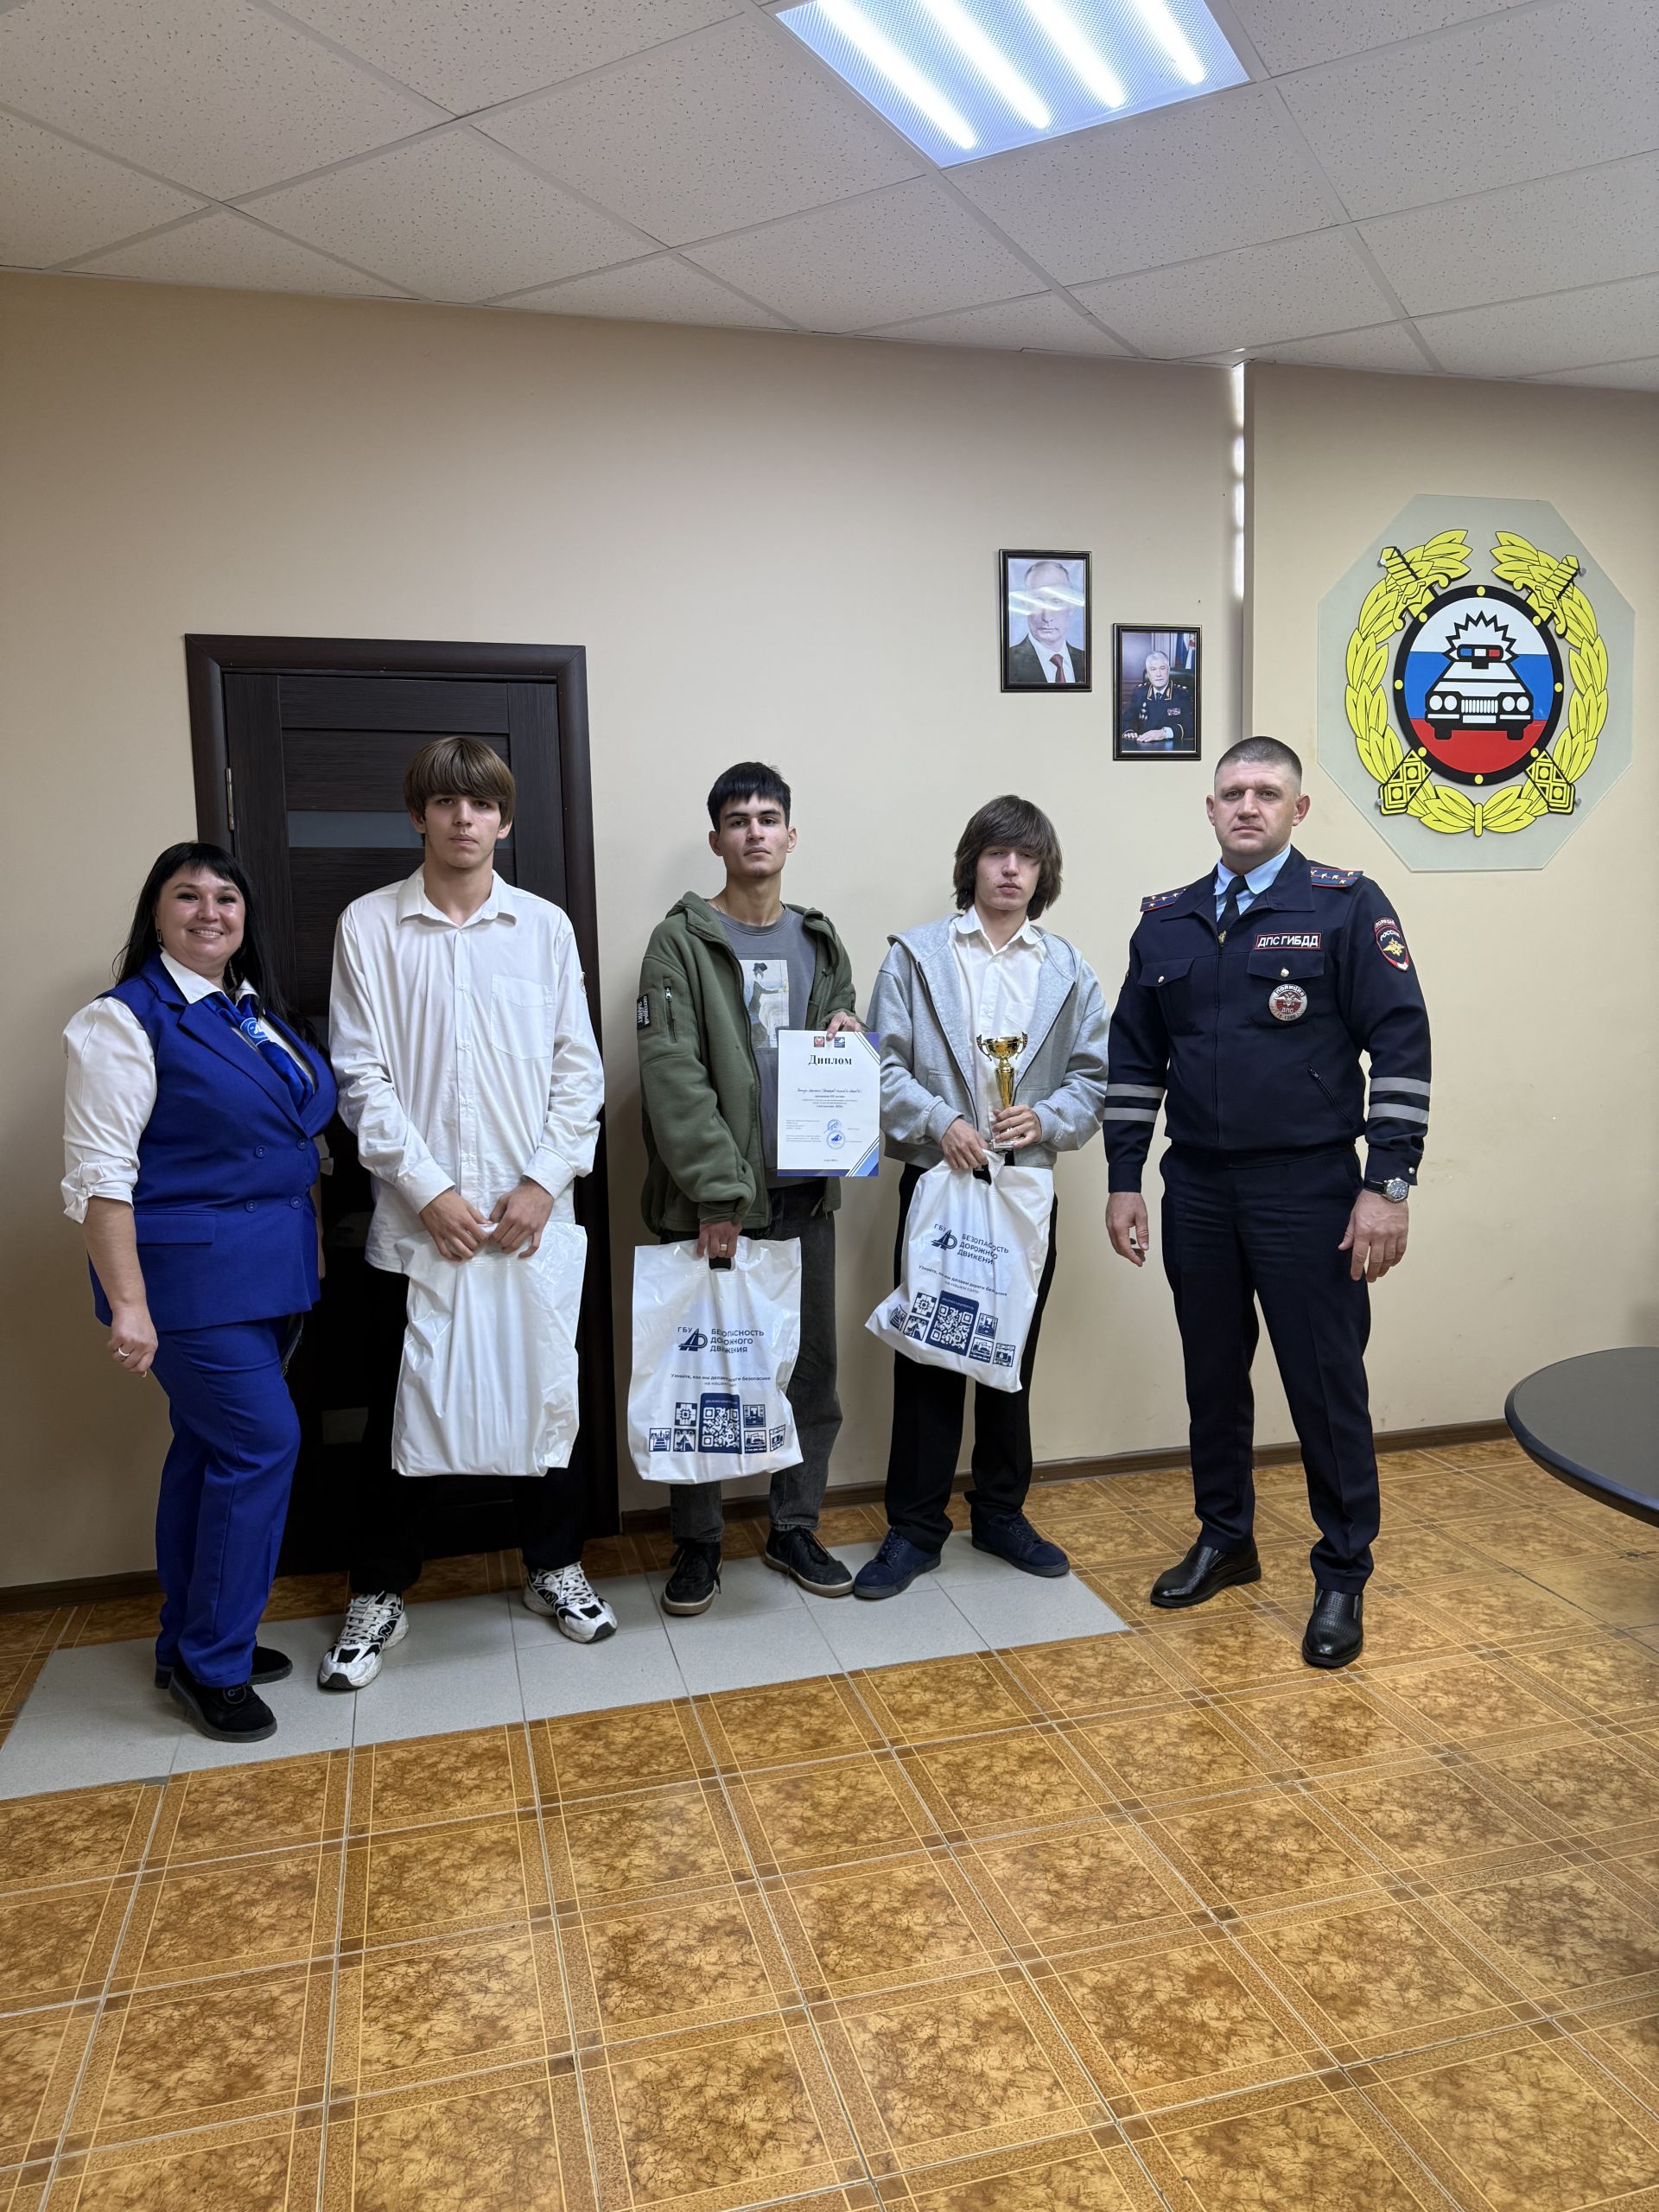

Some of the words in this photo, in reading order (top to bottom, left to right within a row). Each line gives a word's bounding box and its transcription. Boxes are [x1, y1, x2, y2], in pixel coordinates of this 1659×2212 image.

[1257, 937, 1281, 948] ДПС
[1281, 936, 1319, 948] ГИБДД
[1275, 985, 1305, 997] ПОЛИЦИЯ
[808, 1054, 852, 1066] Диплом
[933, 1224, 947, 1233] ГБУ
[962, 1233, 1009, 1254] БЕЗОПАСОСТЬ
[959, 1242, 998, 1260] ДОРОЖНОО
[957, 1249, 995, 1266] ДВИЖЕНИ
[711, 1328, 765, 1338] БЕОПАСНОСТЬ
[710, 1337, 753, 1345] ДООЖНОГО
